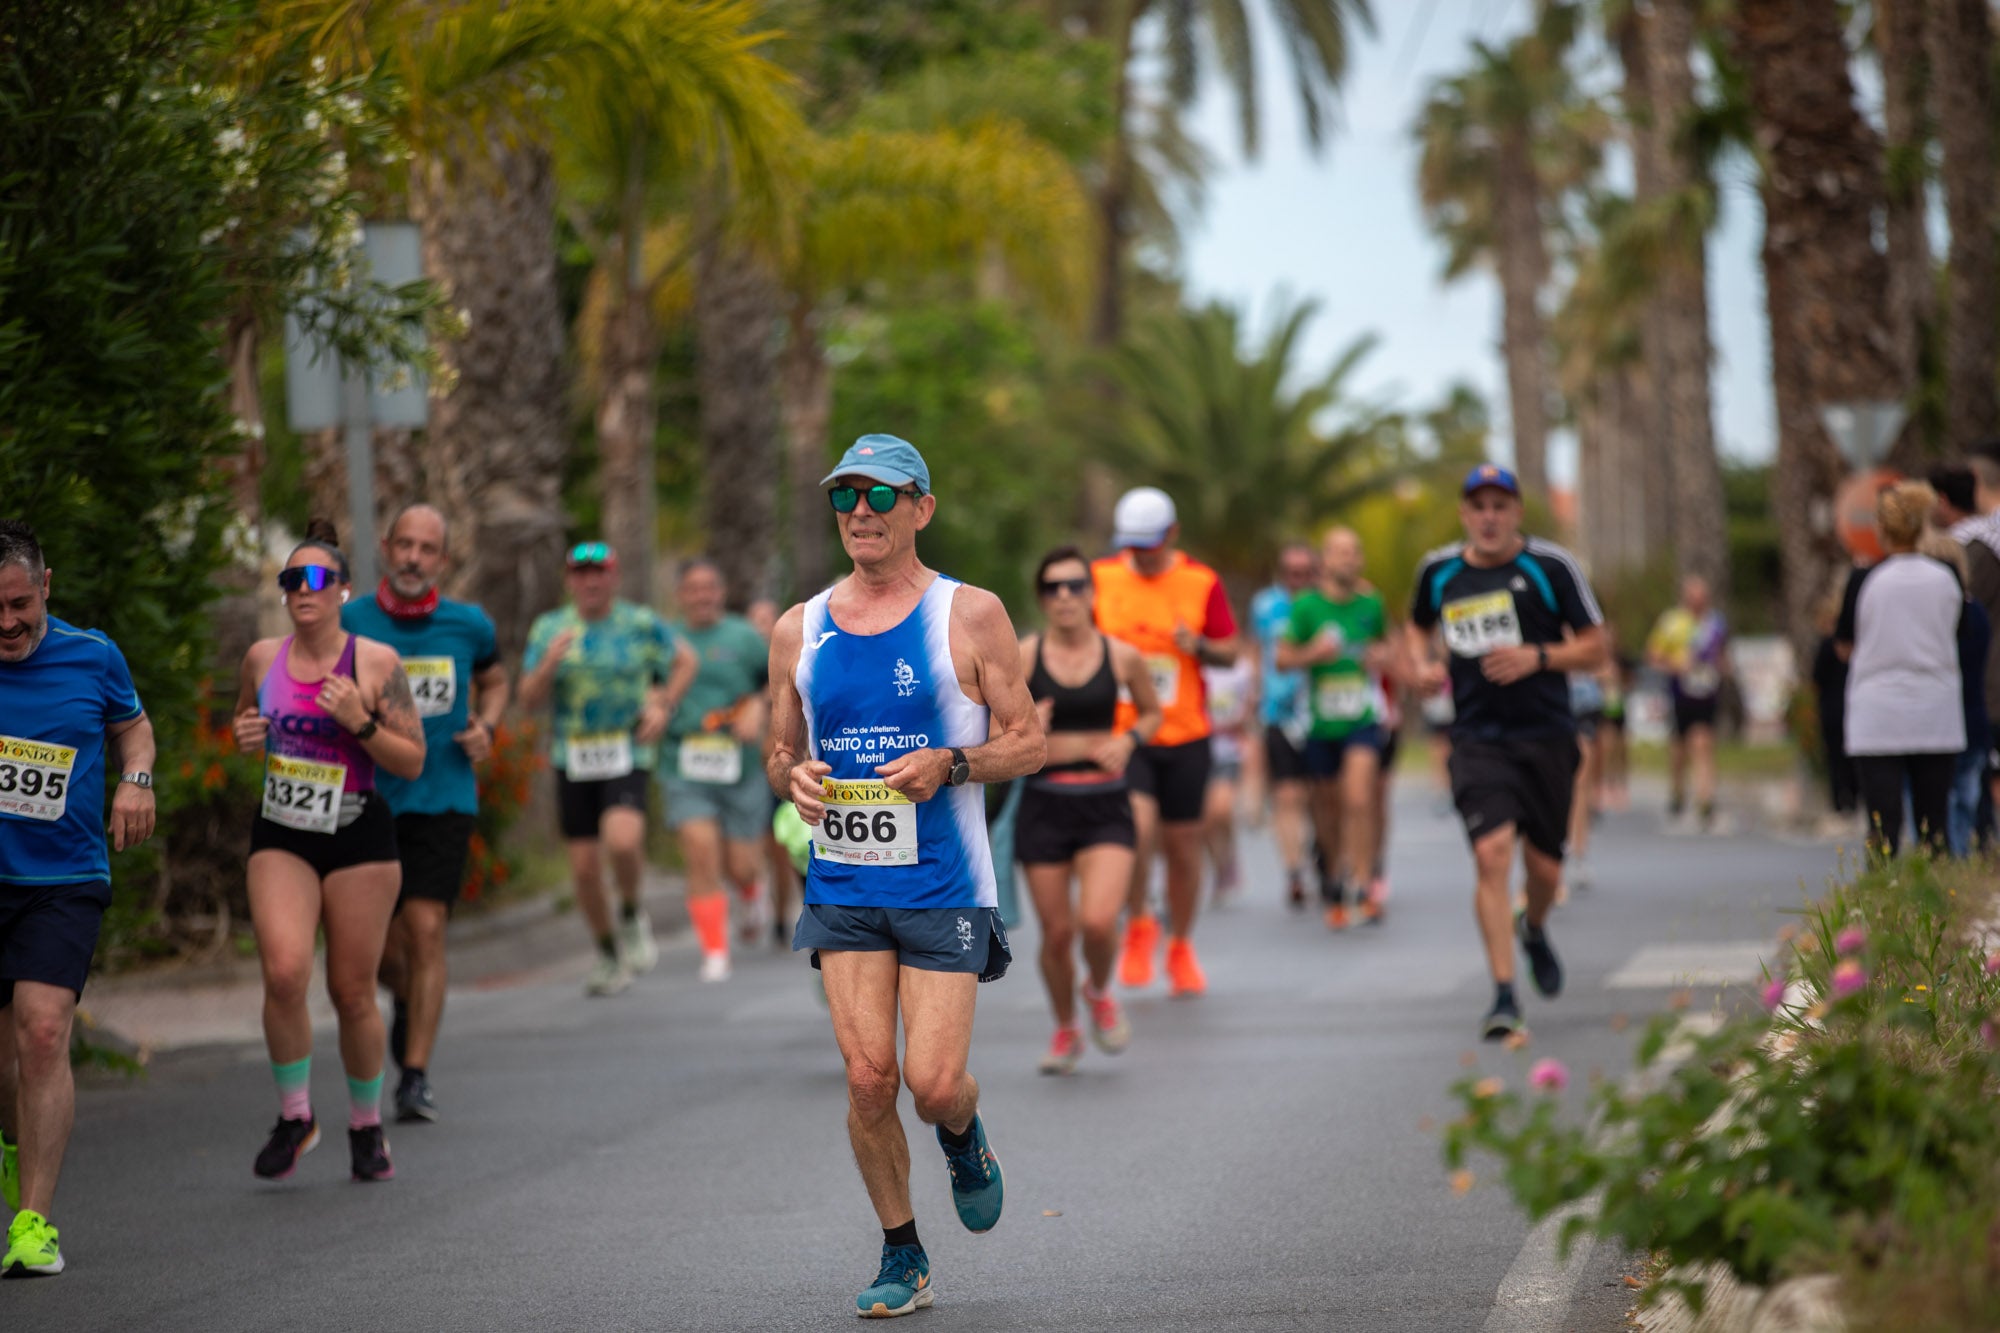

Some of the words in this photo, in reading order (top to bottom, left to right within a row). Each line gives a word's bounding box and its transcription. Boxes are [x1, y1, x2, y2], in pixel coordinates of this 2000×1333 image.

[842, 727, 858, 735] Club
[859, 726, 868, 734] de
[869, 725, 900, 733] Atletismo
[820, 737, 861, 751] PAZITO
[865, 739, 875, 750] a
[880, 733, 928, 749] PAZITO
[4, 745, 55, 763] FONDO
[855, 752, 885, 764] Motril
[267, 777, 334, 815] 3321
[833, 789, 889, 800] FONDO
[823, 809, 897, 843] 666
